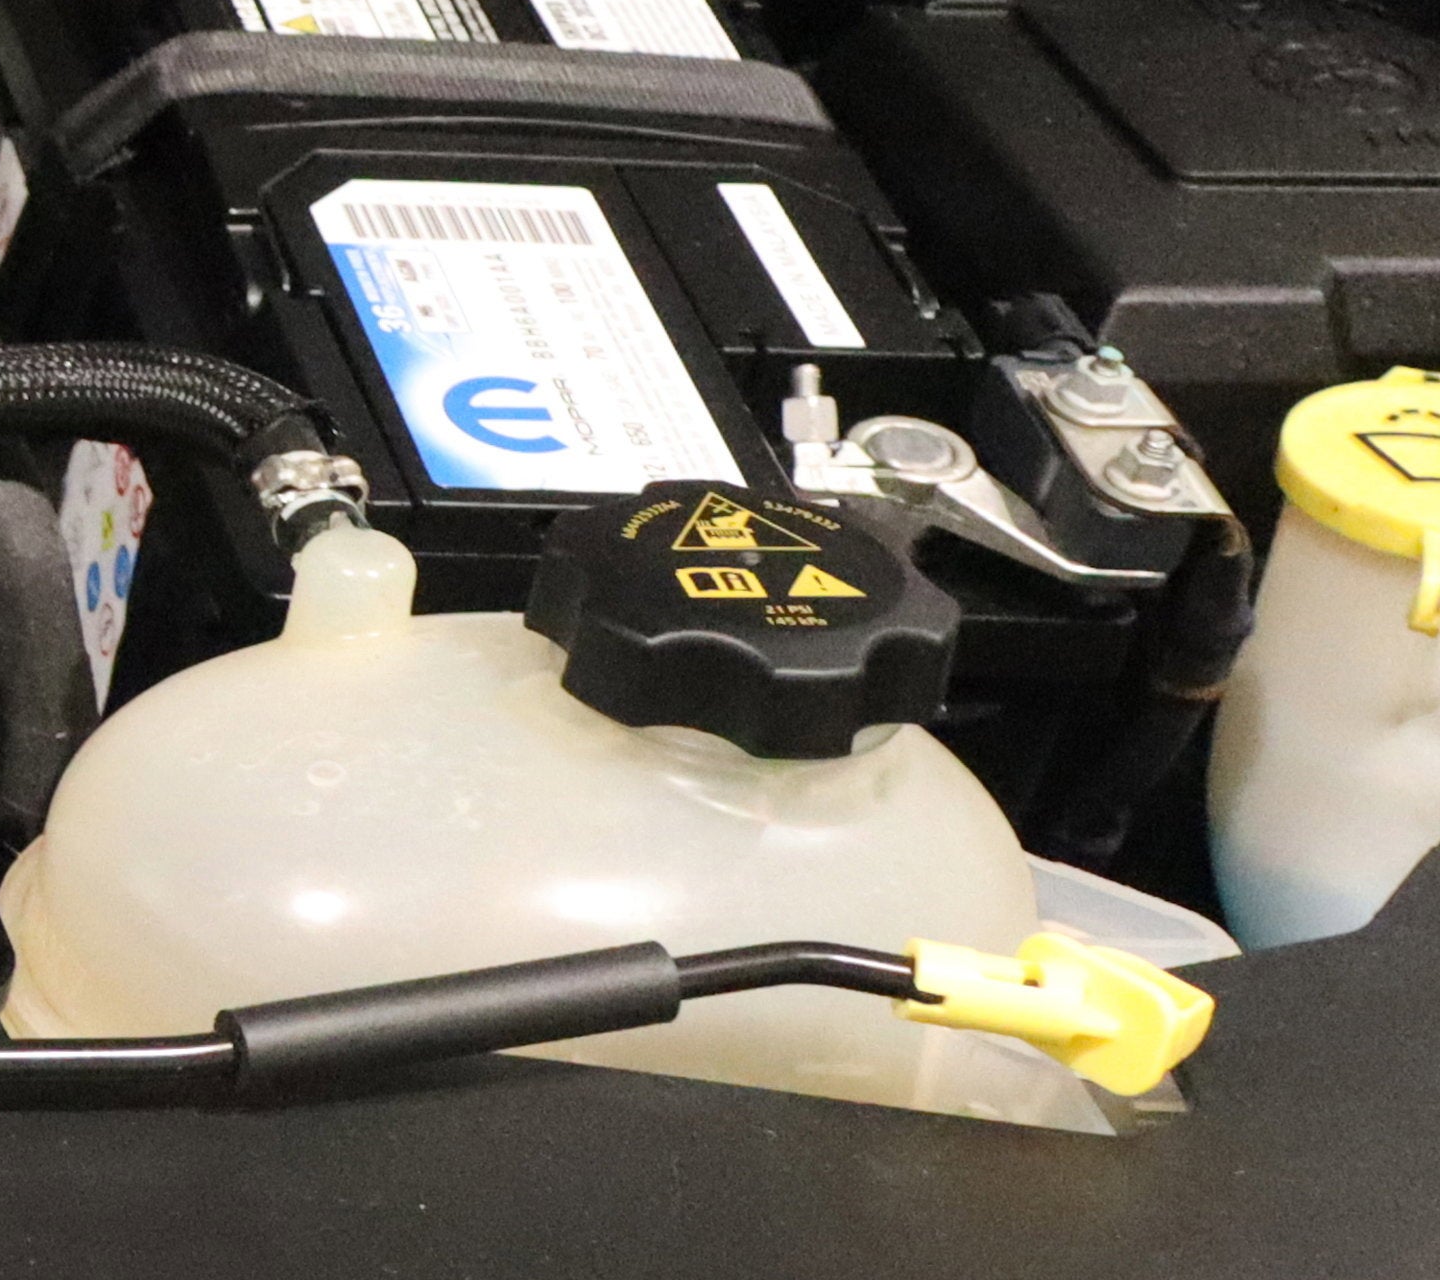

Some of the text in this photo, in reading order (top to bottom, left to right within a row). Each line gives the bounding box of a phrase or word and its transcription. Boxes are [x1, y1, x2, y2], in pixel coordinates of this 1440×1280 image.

[370, 304, 413, 332] 36
[550, 377, 603, 455] MOPAR
[787, 605, 814, 614] PSI
